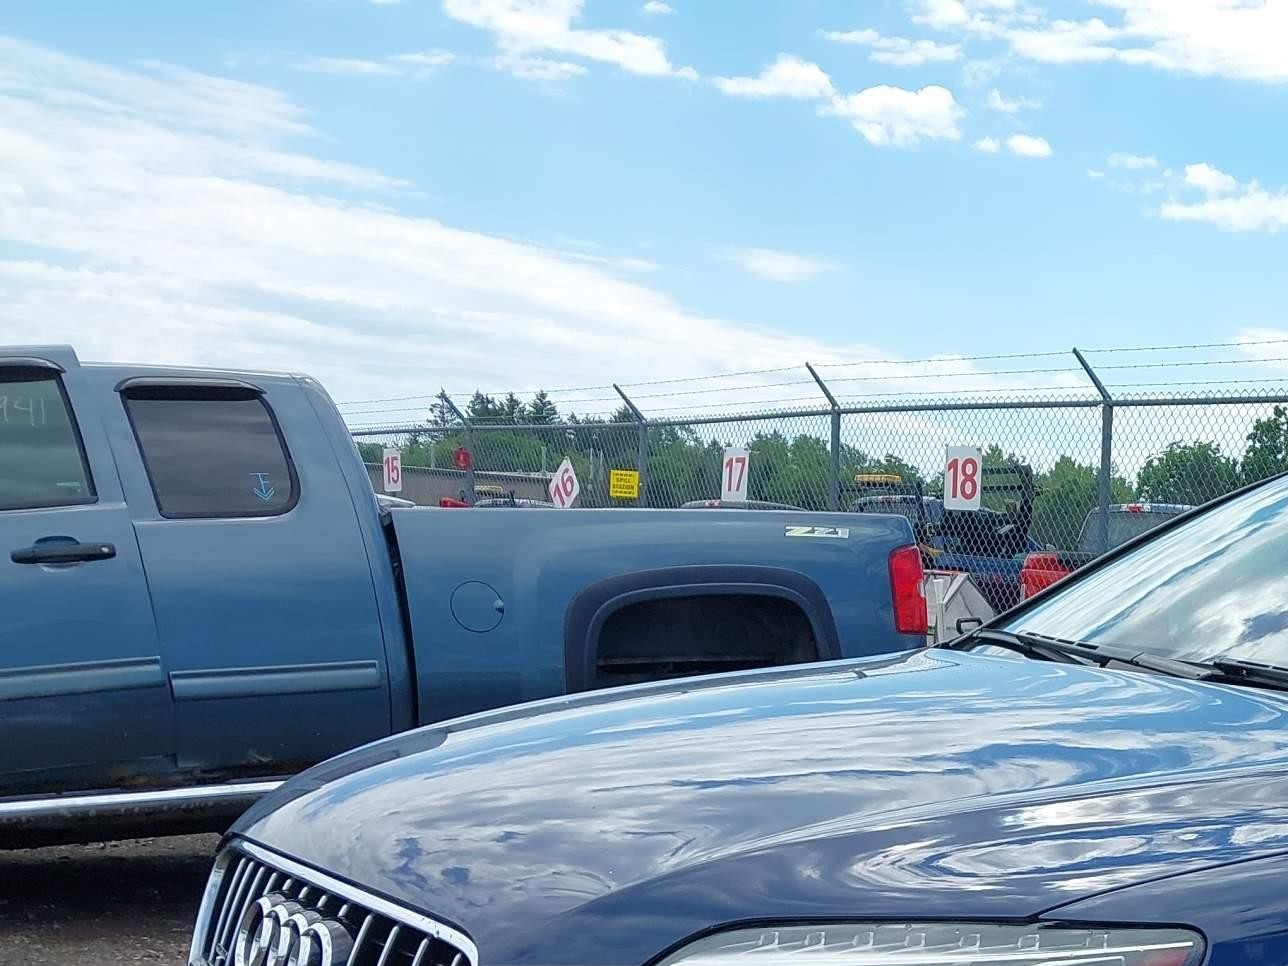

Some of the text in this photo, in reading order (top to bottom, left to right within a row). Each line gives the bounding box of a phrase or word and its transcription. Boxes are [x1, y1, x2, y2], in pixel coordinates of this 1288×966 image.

[385, 456, 400, 485] 15
[553, 467, 575, 507] 16
[725, 456, 746, 493] 17
[947, 456, 978, 501] 18
